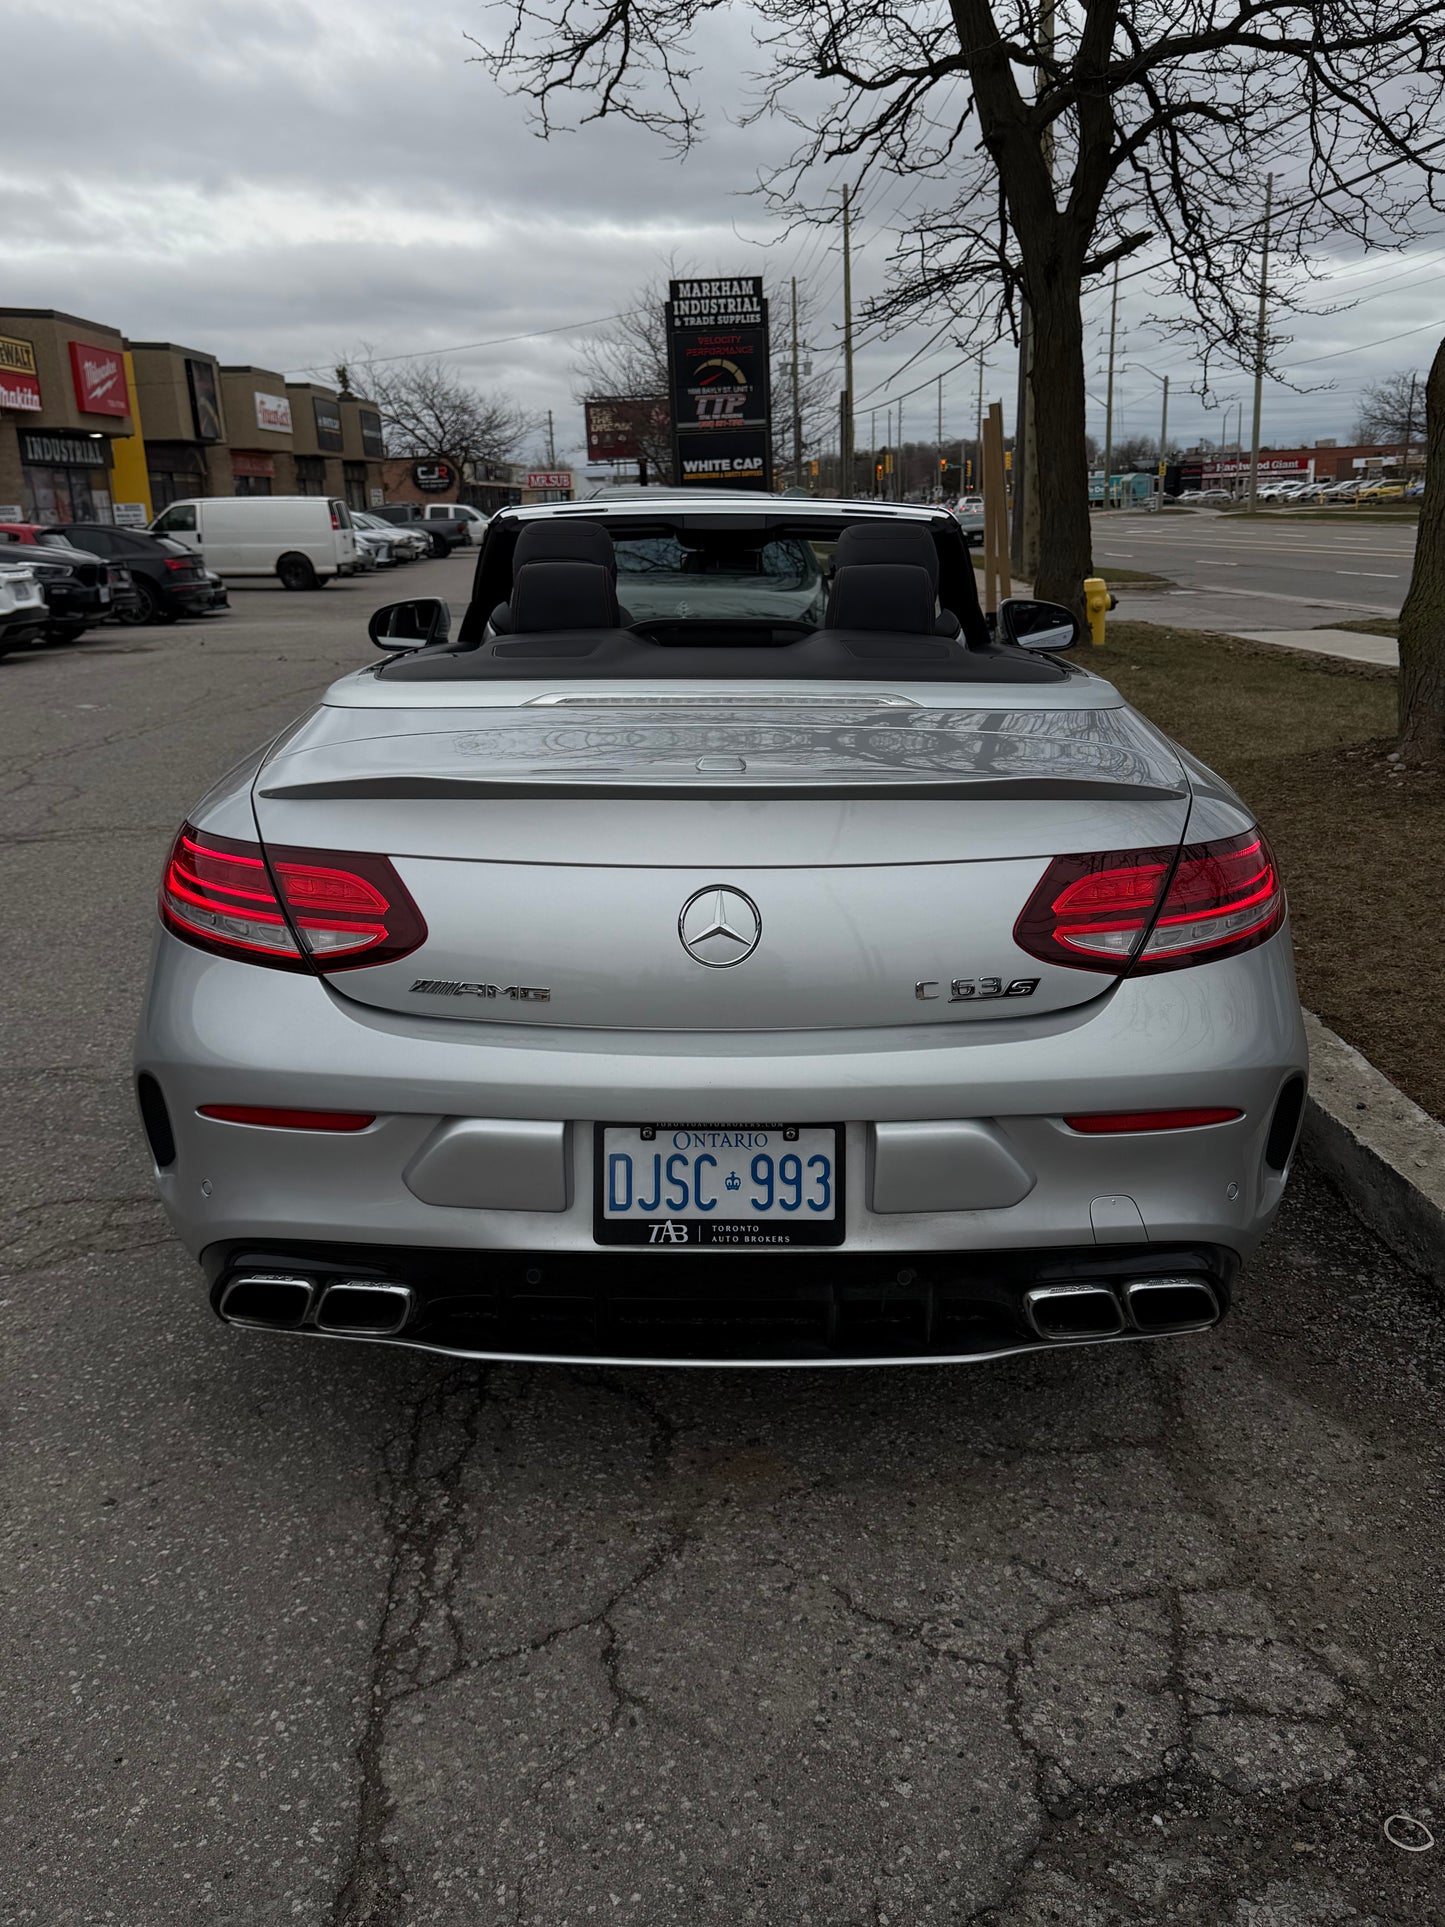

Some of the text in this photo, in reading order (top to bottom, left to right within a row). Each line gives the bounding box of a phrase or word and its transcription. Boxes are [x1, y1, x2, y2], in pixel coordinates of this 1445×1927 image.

[678, 280, 754, 298] MARKHAM
[673, 297, 761, 316] INDUSTRIAL
[674, 314, 762, 327] & TRADE SUPPLIES
[697, 335, 741, 345] VELOCITY
[685, 346, 754, 357] PERFORMANCE
[694, 393, 747, 416] TTP
[25, 436, 104, 464] INDUSTRIAL
[683, 457, 763, 472] WHITE CAP
[1271, 460, 1299, 469] Giant
[453, 982, 550, 1002] AMG
[915, 981, 940, 1000] C
[608, 1153, 831, 1212] DJSC 993
[648, 1219, 689, 1243] TAB
[711, 1235, 791, 1243] AUTO BROKERS
